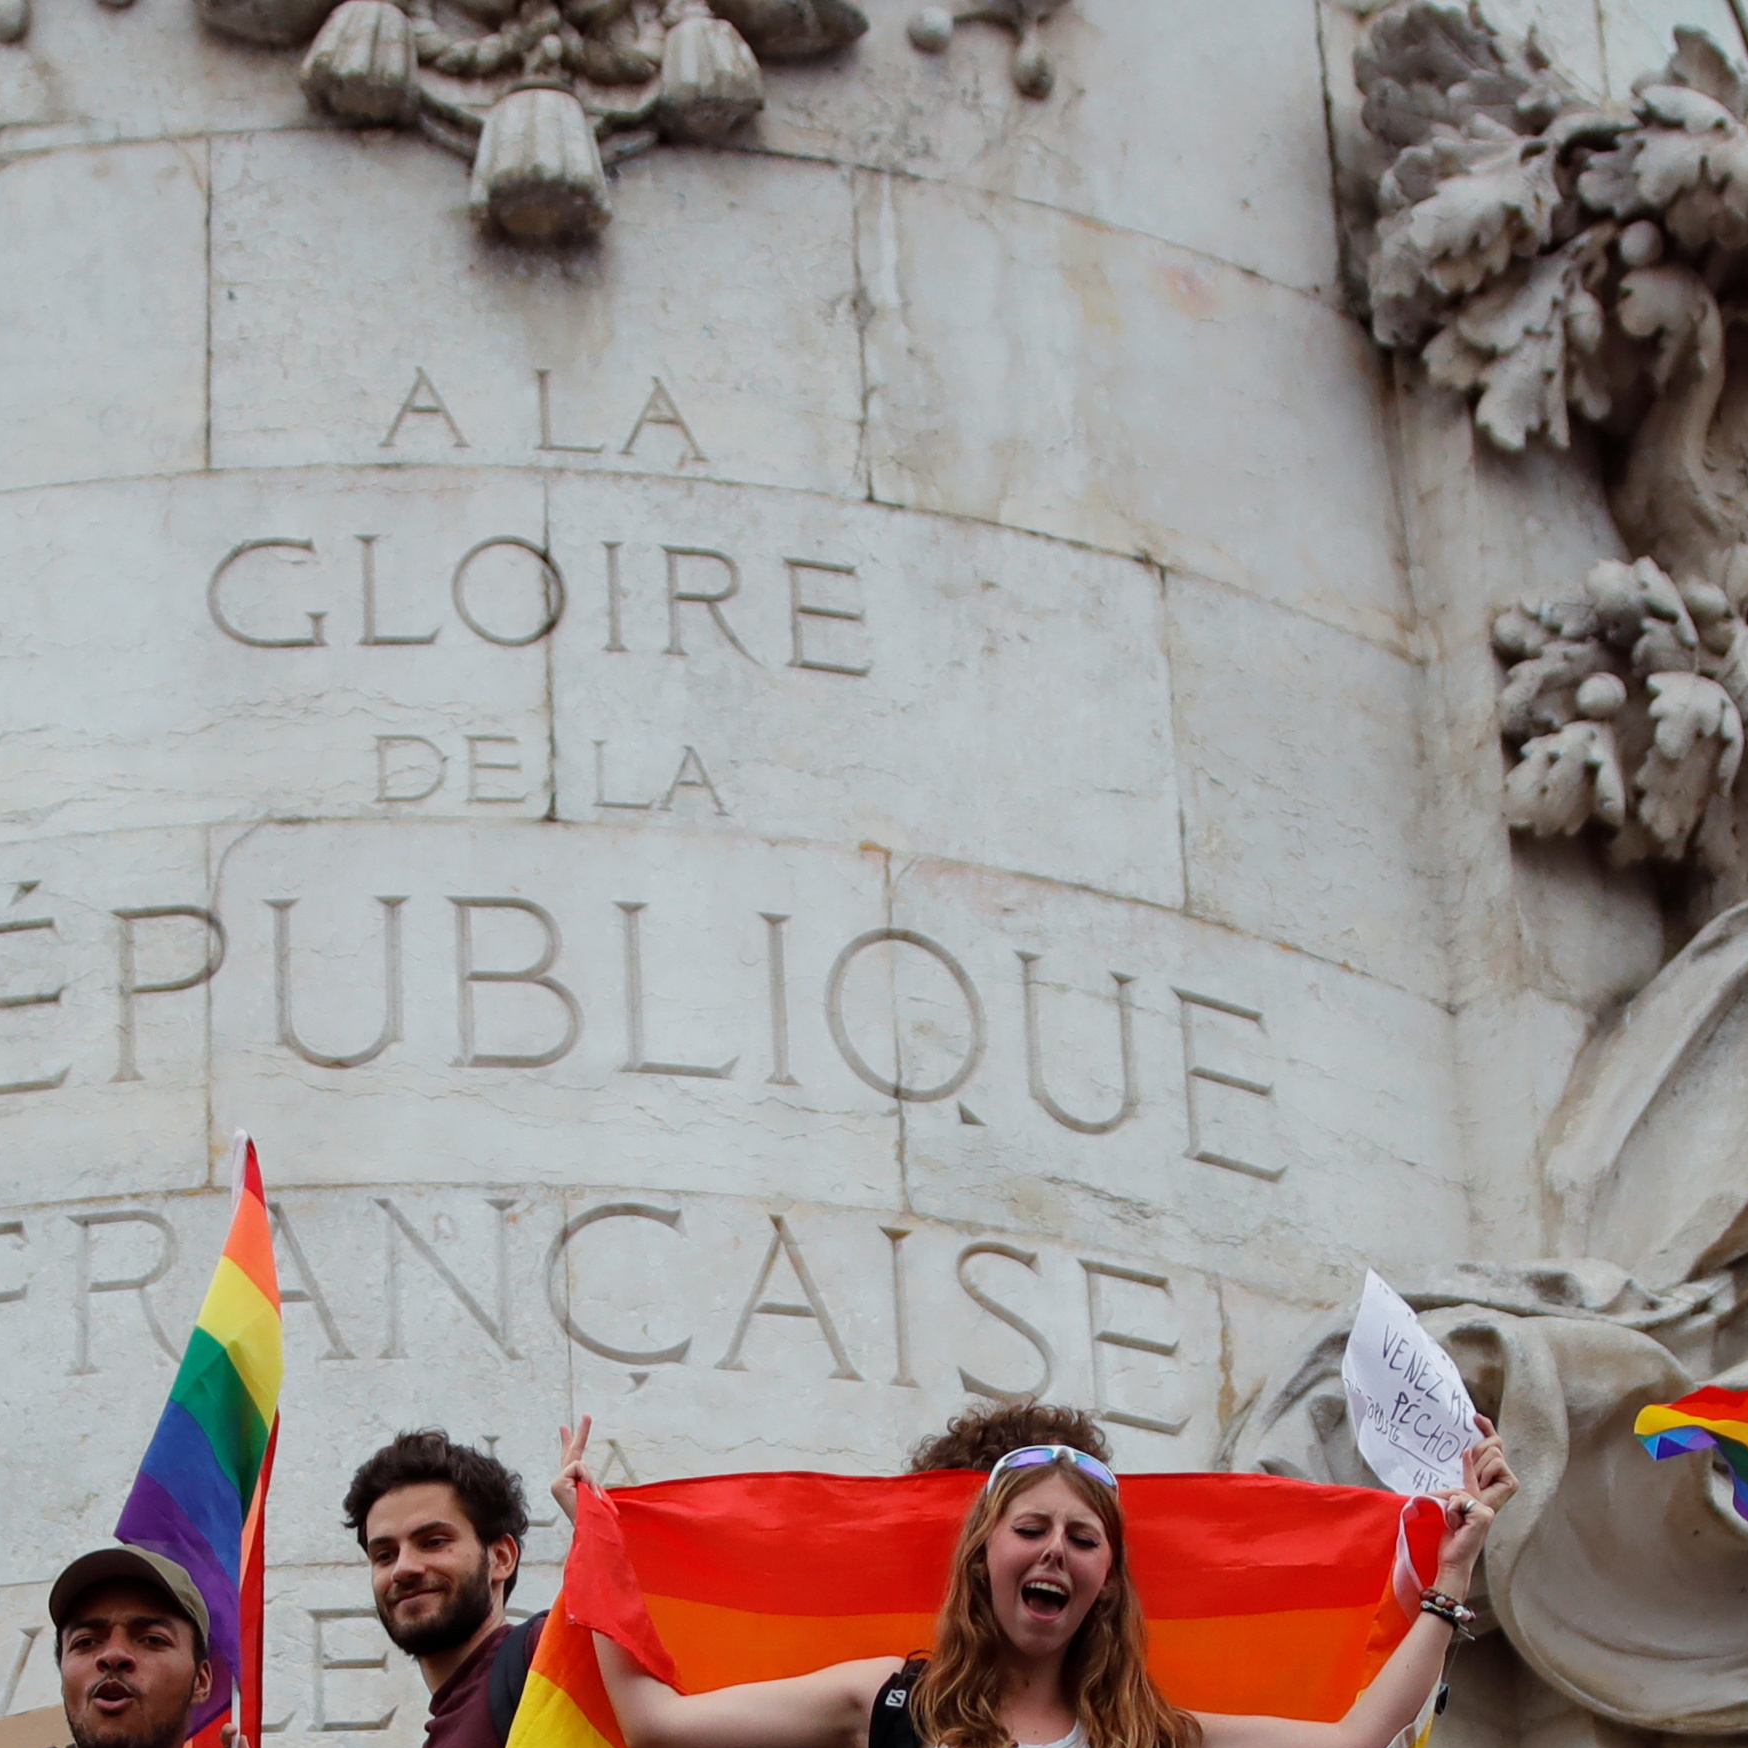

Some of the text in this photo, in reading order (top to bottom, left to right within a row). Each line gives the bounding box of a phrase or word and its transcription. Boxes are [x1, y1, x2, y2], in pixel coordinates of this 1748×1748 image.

[378, 366, 710, 462] A LA
[207, 533, 873, 678] GLOIRE
[373, 734, 730, 816] DE LA
[1382, 1323, 1474, 1434] VENEZ ME
